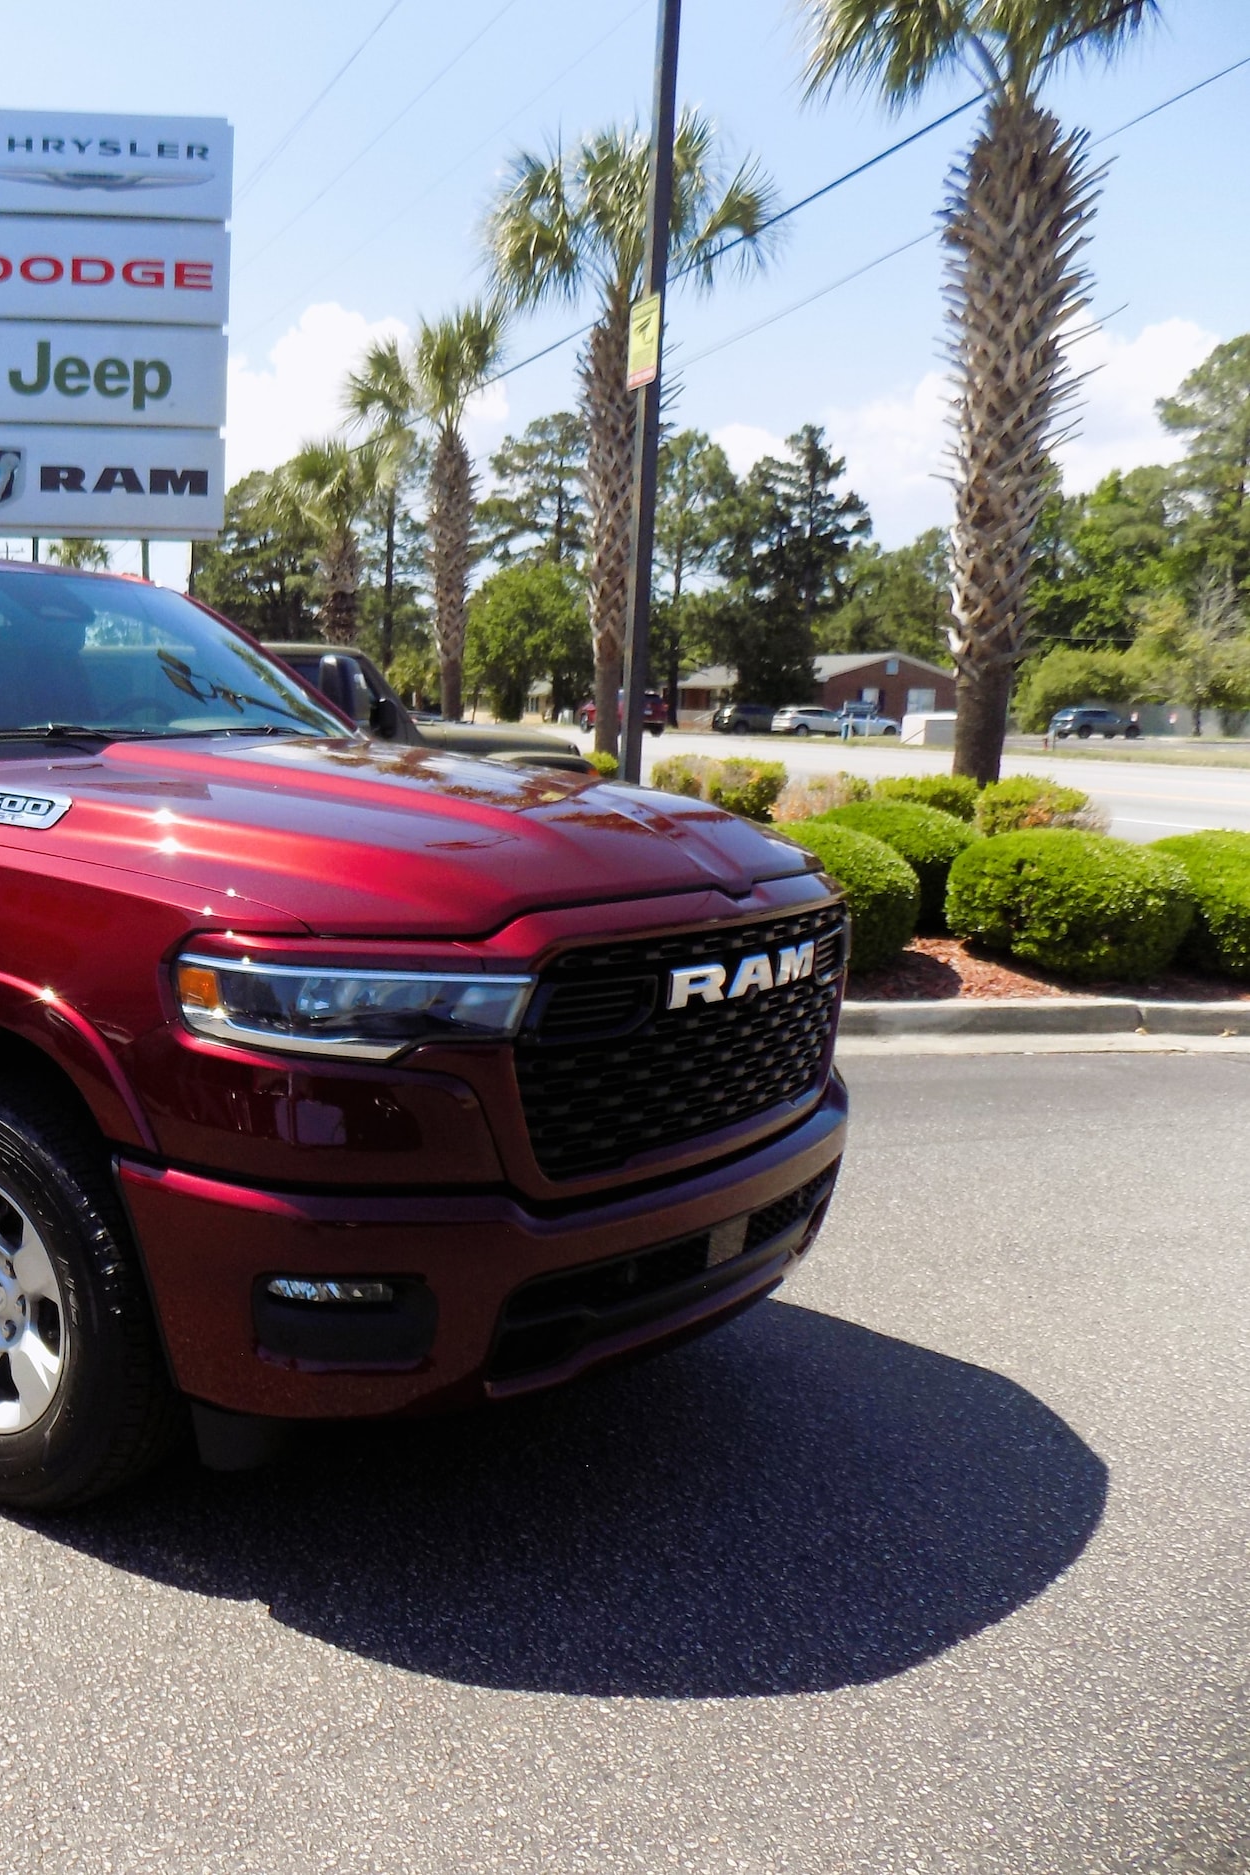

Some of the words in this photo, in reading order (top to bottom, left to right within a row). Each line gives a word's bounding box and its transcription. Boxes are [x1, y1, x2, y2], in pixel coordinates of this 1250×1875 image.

[8, 340, 172, 411] Jeep
[40, 465, 208, 496] RAM
[666, 940, 814, 1010] RAM
